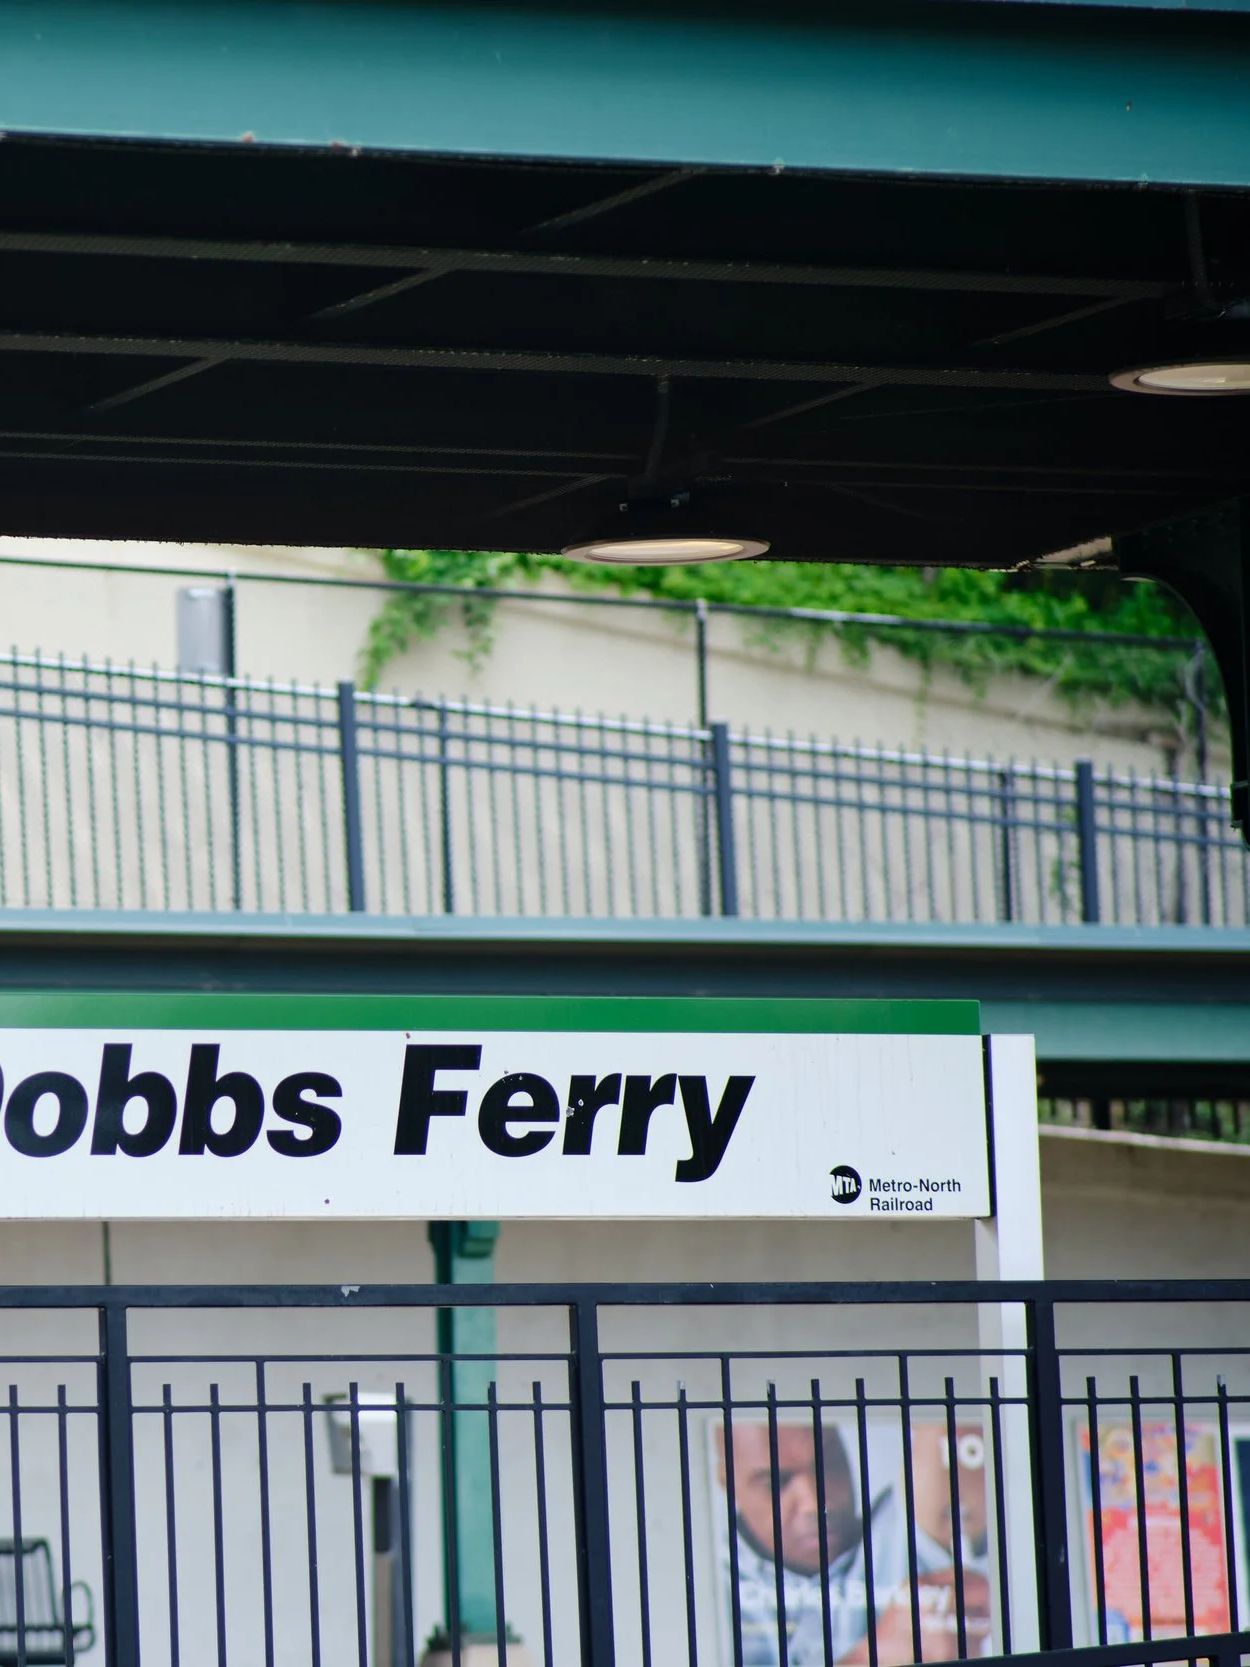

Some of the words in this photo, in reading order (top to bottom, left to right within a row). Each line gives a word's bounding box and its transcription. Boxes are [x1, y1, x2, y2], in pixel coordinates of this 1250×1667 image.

[393, 1044, 756, 1184] Ferry
[829, 1169, 862, 1200] MTA
[869, 1178, 961, 1193] Metro-North
[870, 1197, 933, 1211] Railroad
